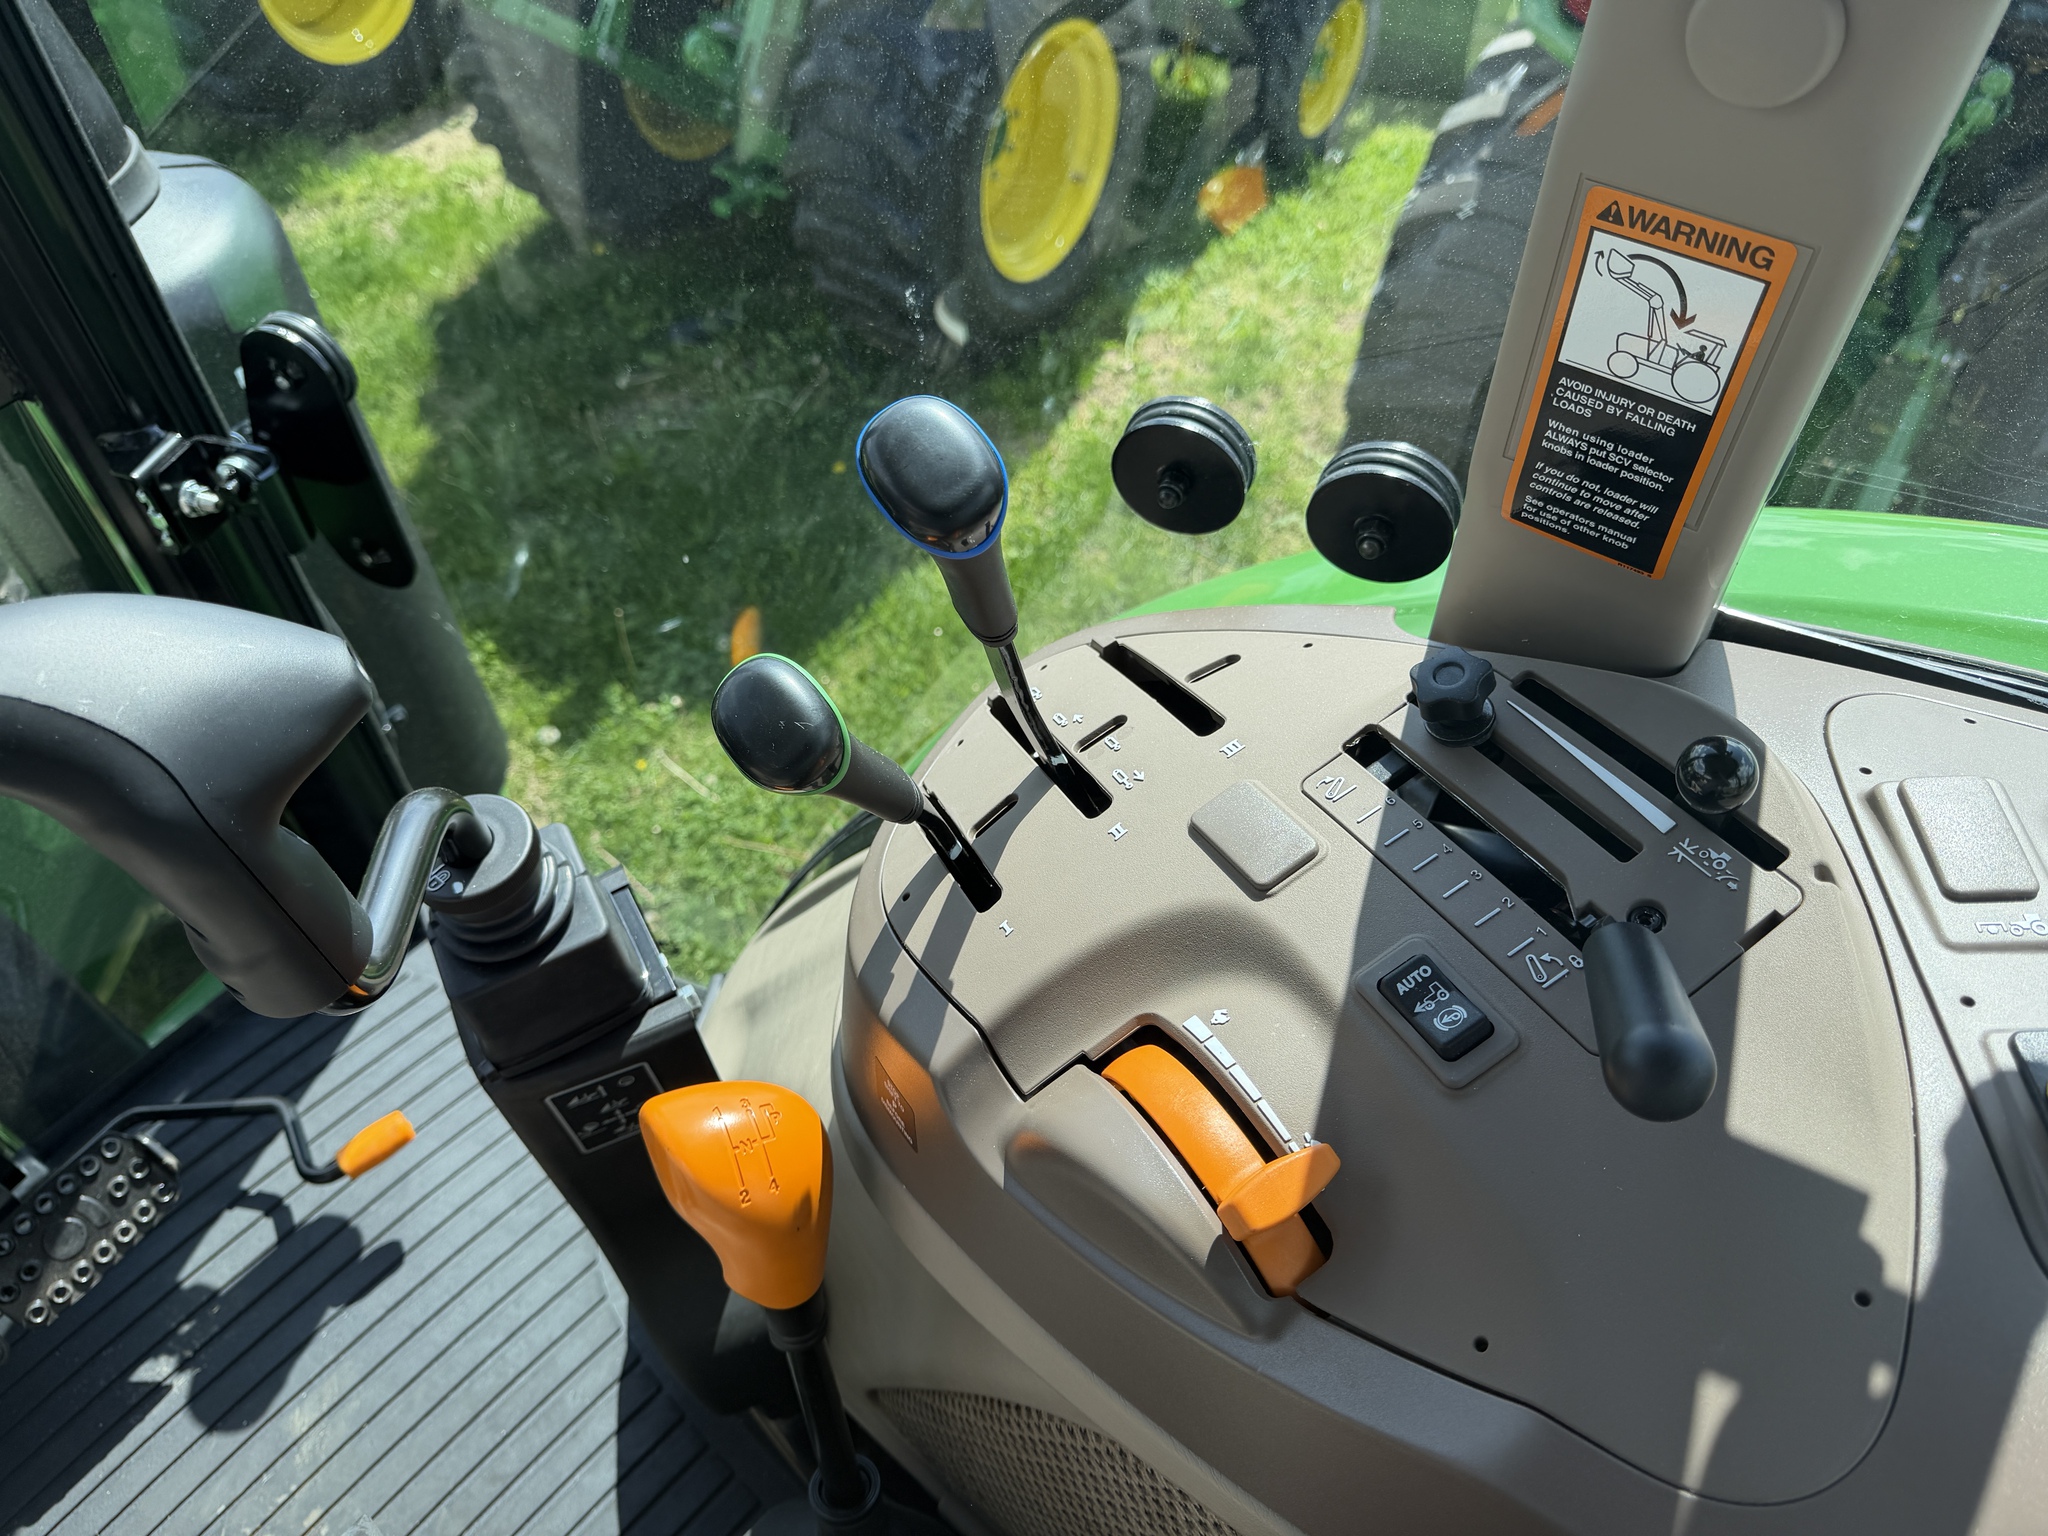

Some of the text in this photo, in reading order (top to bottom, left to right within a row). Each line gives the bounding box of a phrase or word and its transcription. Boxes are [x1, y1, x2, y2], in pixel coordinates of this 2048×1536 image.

[1628, 206, 1775, 271] WARNING
[1552, 398, 1592, 418] LOADS
[1556, 388, 1676, 436] CAUSED BY FALLING
[1559, 377, 1696, 432] AVOID INJURY OR DEATH
[1548, 419, 1654, 464] When using loader
[1542, 439, 1664, 492] knobs in loader position.
[1545, 430, 1674, 484] ALWAYS put SCV selector
[1532, 472, 1650, 521] continue to move after
[1535, 461, 1659, 514] If you do not, loader will
[1525, 495, 1637, 544] See operators manual
[1529, 482, 1640, 530] controls are released.
[1521, 512, 1570, 534] positions.
[1523, 503, 1537, 513] for
[1539, 512, 1557, 521] use
[1573, 524, 1600, 538] other
[1602, 534, 1629, 550] knob
[1385, 794, 1397, 805] 6
[1413, 819, 1424, 830] 5
[1442, 843, 1454, 854] 4
[1471, 869, 1482, 880] 3
[1501, 897, 1516, 909] 2
[1536, 926, 1547, 937] 1
[1396, 965, 1432, 995] AUTO
[740, 1138, 753, 1155] N
[739, 1188, 751, 1206] 2
[769, 1177, 780, 1193] 4
